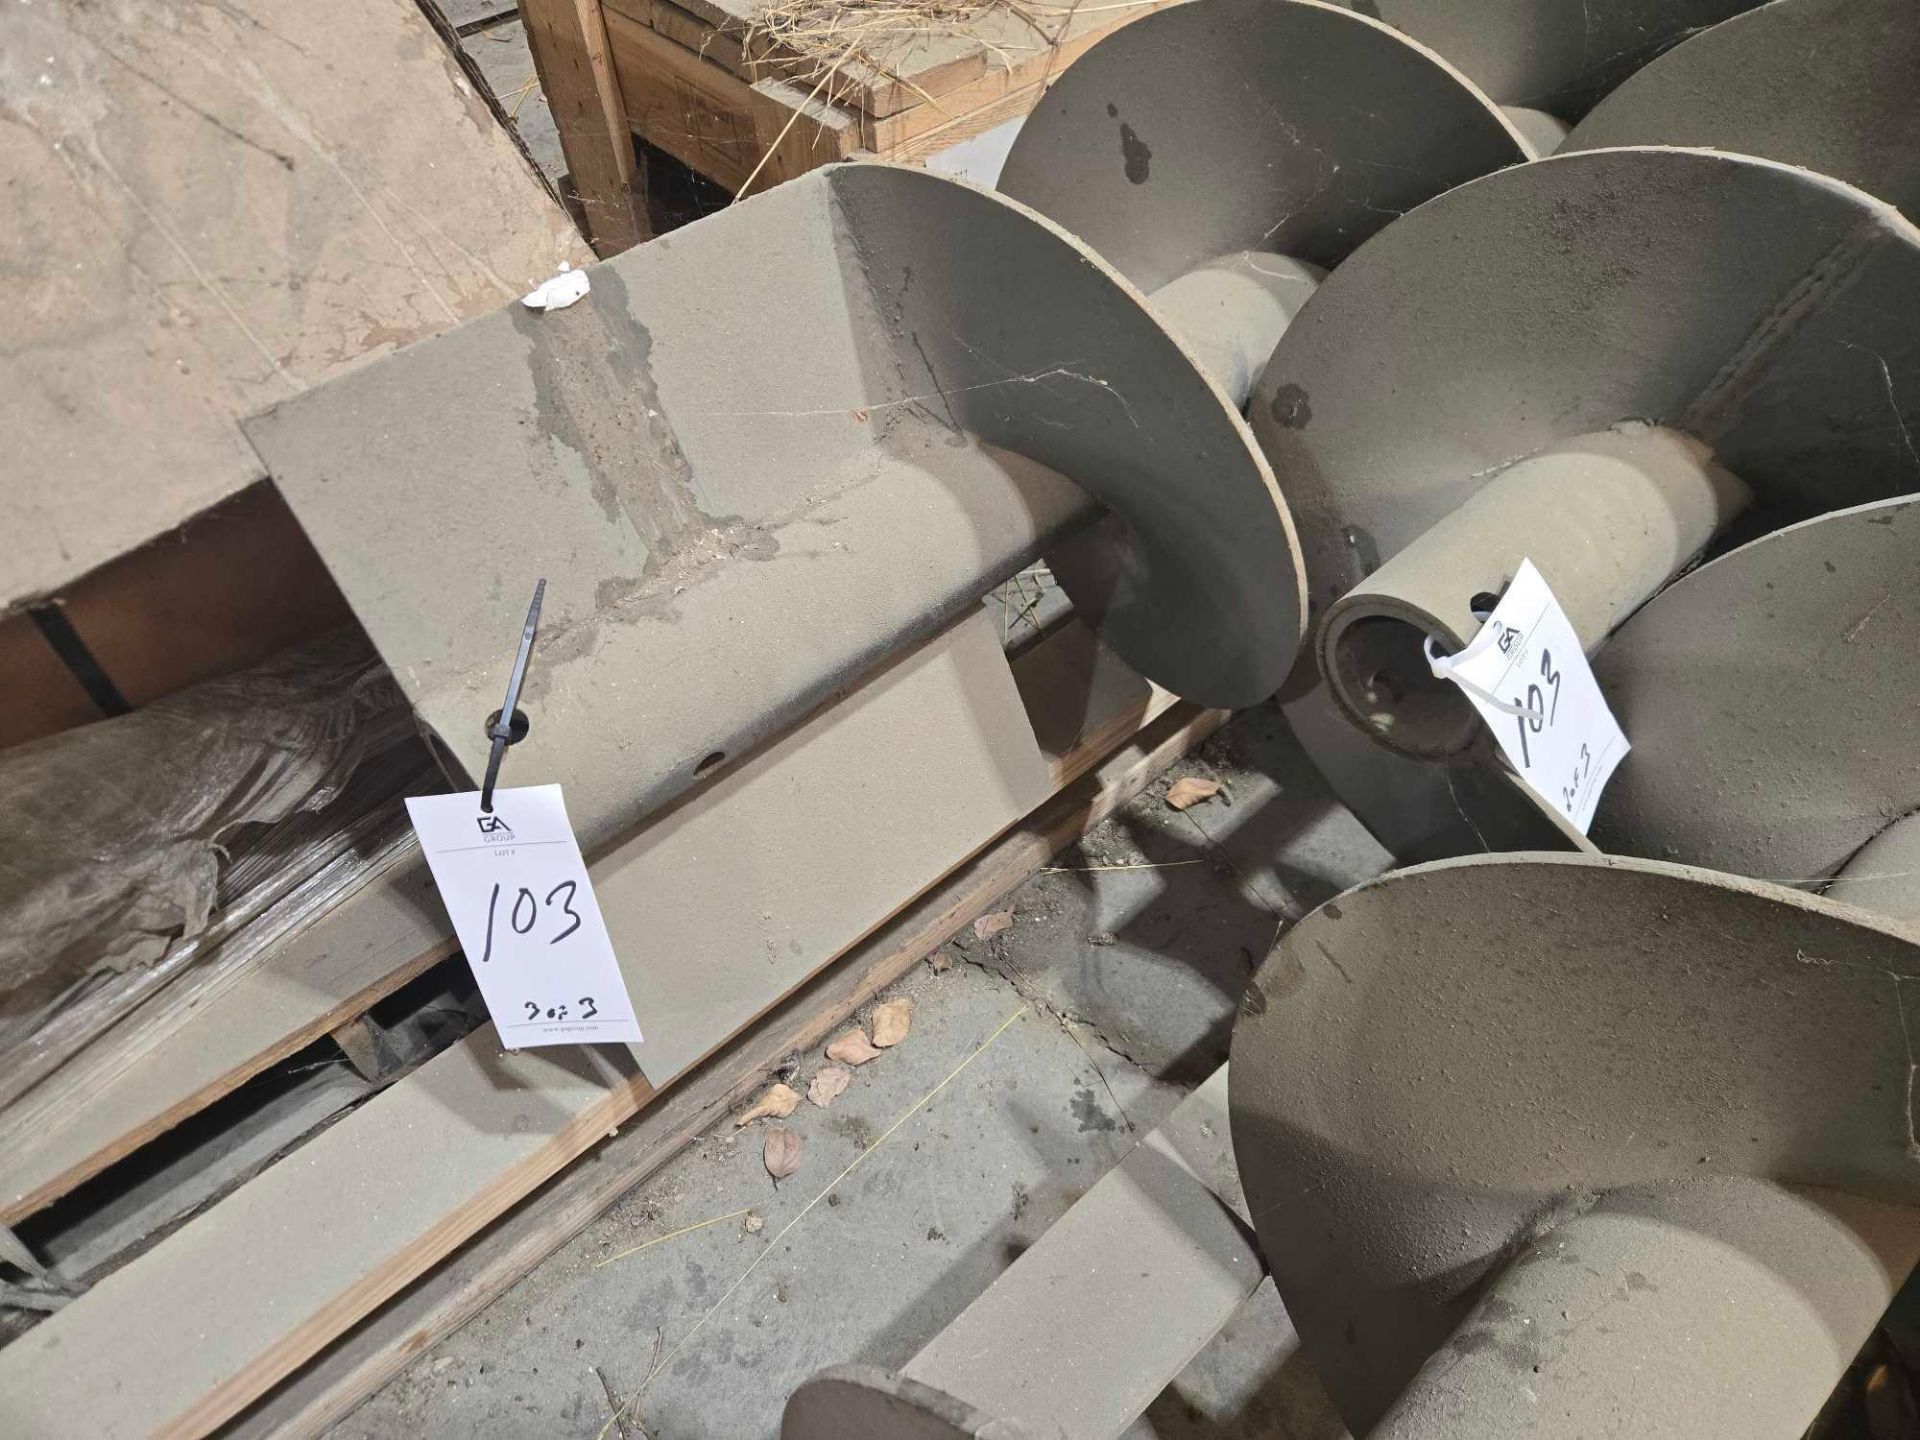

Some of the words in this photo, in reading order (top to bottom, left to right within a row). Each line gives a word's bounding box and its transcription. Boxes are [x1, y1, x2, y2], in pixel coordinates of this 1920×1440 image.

[1514, 648, 1561, 769] 103
[1580, 742, 1591, 779] 3
[476, 816, 512, 833] GA
[482, 880, 582, 962] 103
[524, 1001, 540, 1020] 3
[578, 997, 598, 1019] 3
